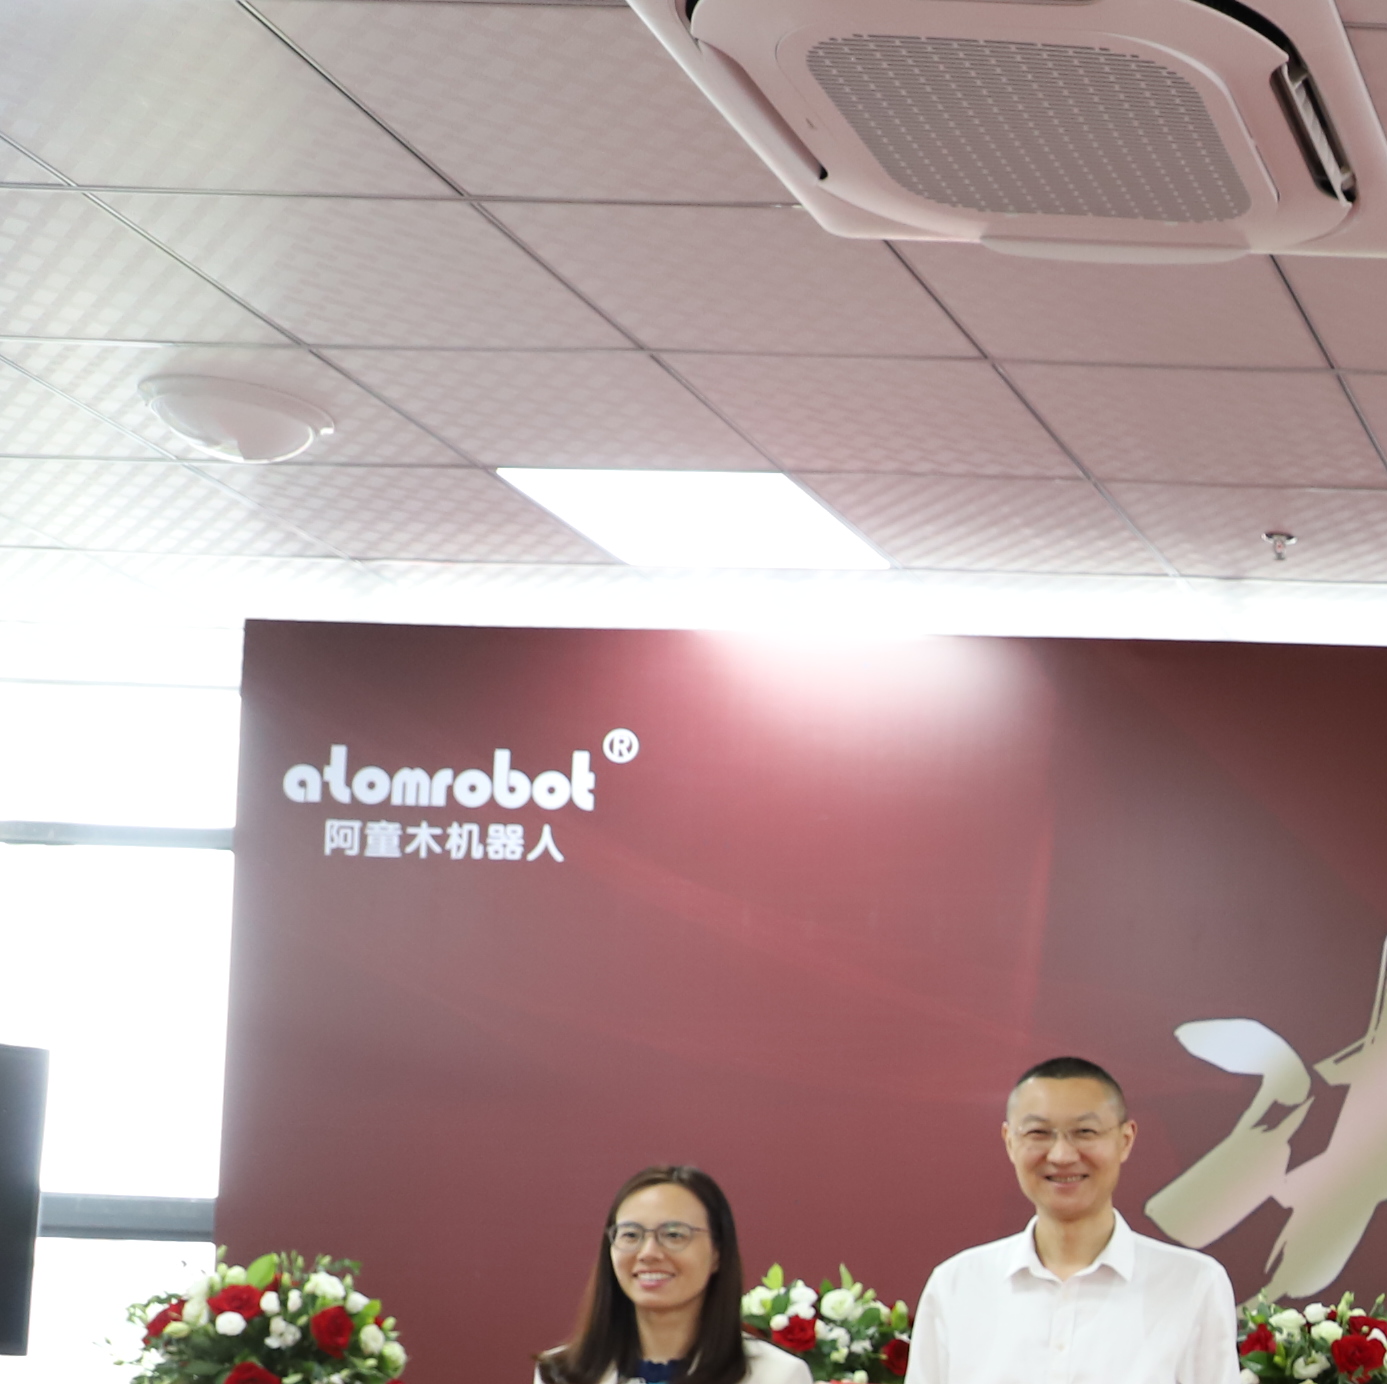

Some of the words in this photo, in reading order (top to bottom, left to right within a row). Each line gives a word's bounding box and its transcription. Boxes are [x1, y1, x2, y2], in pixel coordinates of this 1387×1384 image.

[283, 744, 595, 812] atomrobot
[324, 819, 564, 862] 阿童木机器人
